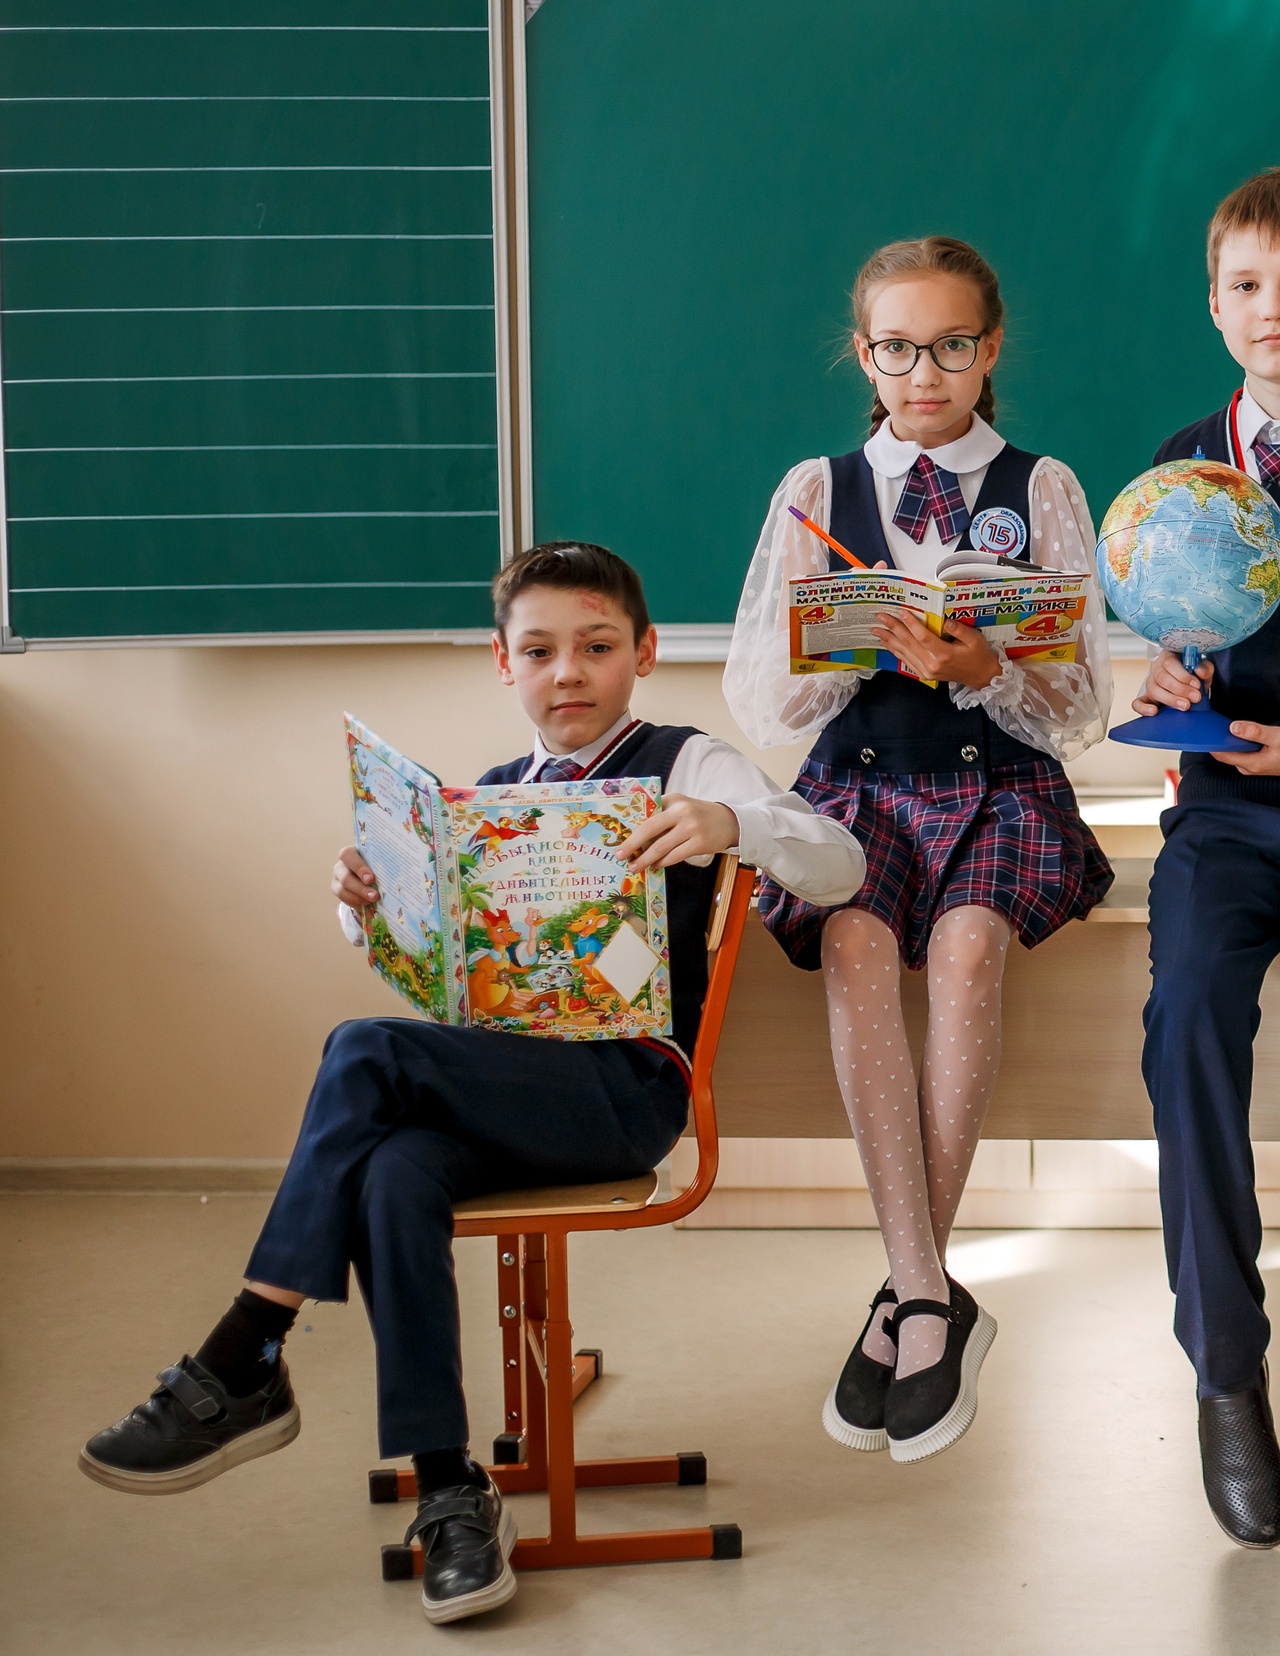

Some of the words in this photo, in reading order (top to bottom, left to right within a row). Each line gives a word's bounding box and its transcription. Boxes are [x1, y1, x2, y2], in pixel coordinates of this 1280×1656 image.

[972, 513, 987, 531] ЦЕНТР
[1000, 510, 1025, 546] ОБРАЗОВАНИЯ
[987, 522, 1011, 546] 15
[796, 585, 904, 597] ОЛИМПИАДЫ
[910, 592, 929, 601] ПО
[796, 592, 906, 605] МАТЕМАТИКЕ
[946, 584, 1081, 602] ОЛИМПИАДЫ
[803, 606, 827, 619] 4
[944, 600, 1078, 620] МАТЕМАТИКЕ
[1023, 615, 1060, 633] 4
[1015, 633, 1071, 641] КЛАСС
[463, 840, 627, 884] НЕОБЫКНОВЕННА
[528, 855, 574, 867] КНИГА
[543, 866, 561, 875] ОБ
[487, 875, 618, 891] УДИВИТЕЛЬНЫХ
[501, 890, 604, 906] ЖИВОТНЫХ
